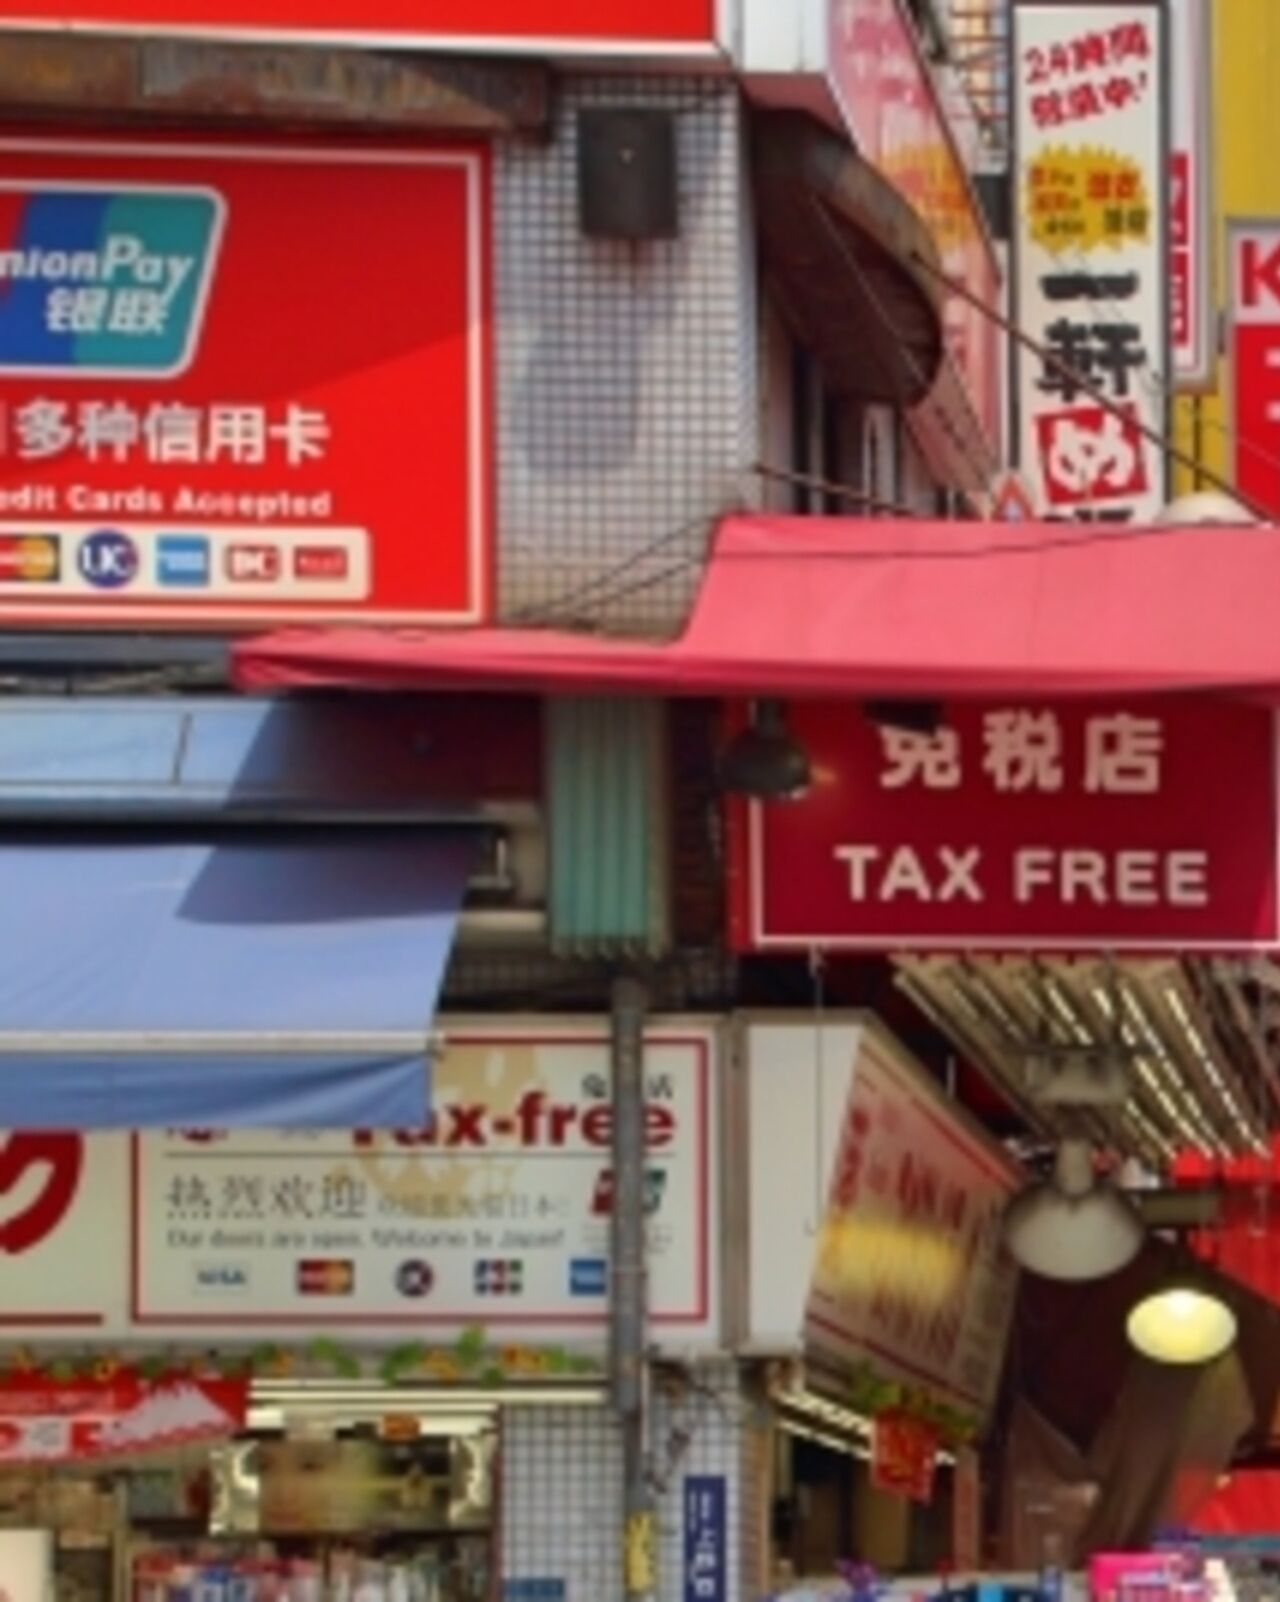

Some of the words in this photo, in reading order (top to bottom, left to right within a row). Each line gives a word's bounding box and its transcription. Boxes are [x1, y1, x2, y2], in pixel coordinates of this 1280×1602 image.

[0, 397, 330, 466] 多种信用卡
[67, 486, 163, 513] Cards
[173, 488, 332, 519] Accepted
[880, 709, 1163, 793] 免税店
[834, 845, 984, 901] TAX
[1013, 850, 1209, 905] FREE
